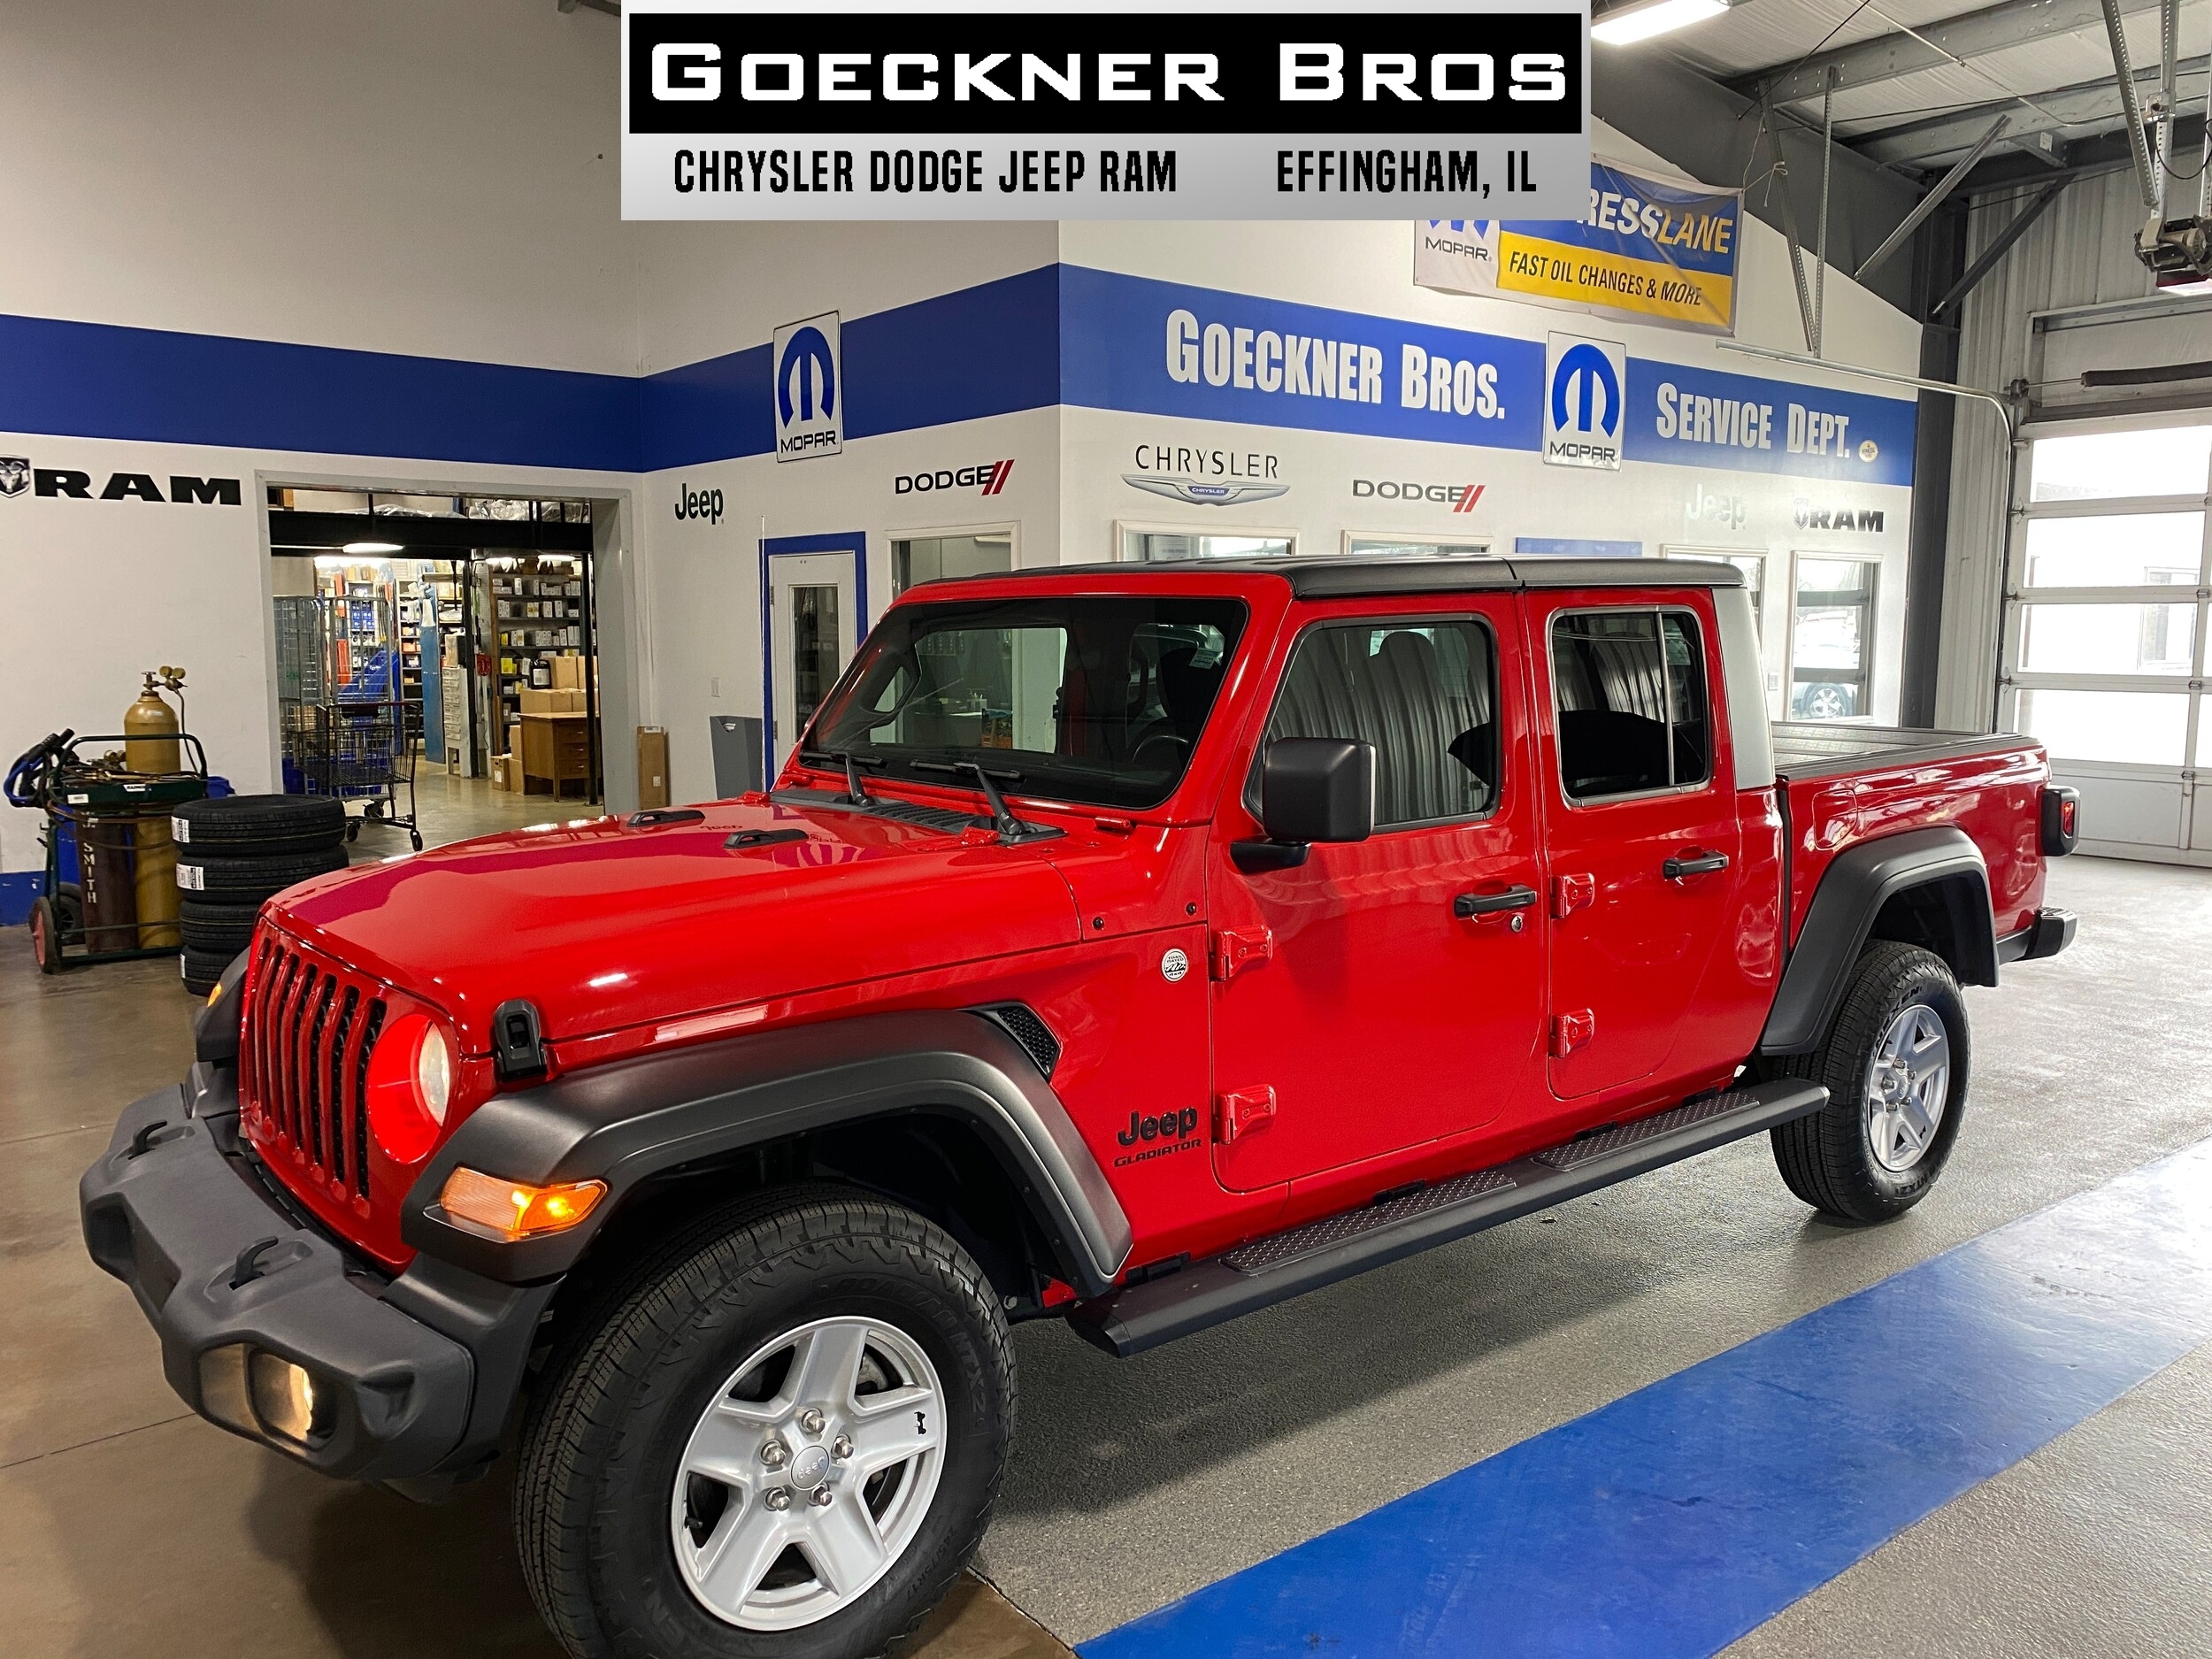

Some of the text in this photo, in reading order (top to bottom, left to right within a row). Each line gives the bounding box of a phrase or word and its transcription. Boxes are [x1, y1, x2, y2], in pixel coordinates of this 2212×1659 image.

[1425, 236, 1488, 261] MOPAR
[1509, 250, 1701, 306] FAST OIL CHANGES & MORE
[780, 430, 837, 454] MOPAR
[1550, 441, 1616, 462] MOPAR
[1134, 444, 1279, 479] CHRYSLER
[33, 468, 242, 505] RAM
[895, 464, 996, 495] DODGE
[1352, 480, 1468, 504] DODGE
[674, 483, 724, 525] Jeep
[1685, 483, 1747, 530] Jeep
[1809, 509, 1885, 533] RAM
[1117, 1106, 1198, 1146] Jeep
[1114, 1139, 1202, 1167] GLADIATOR
